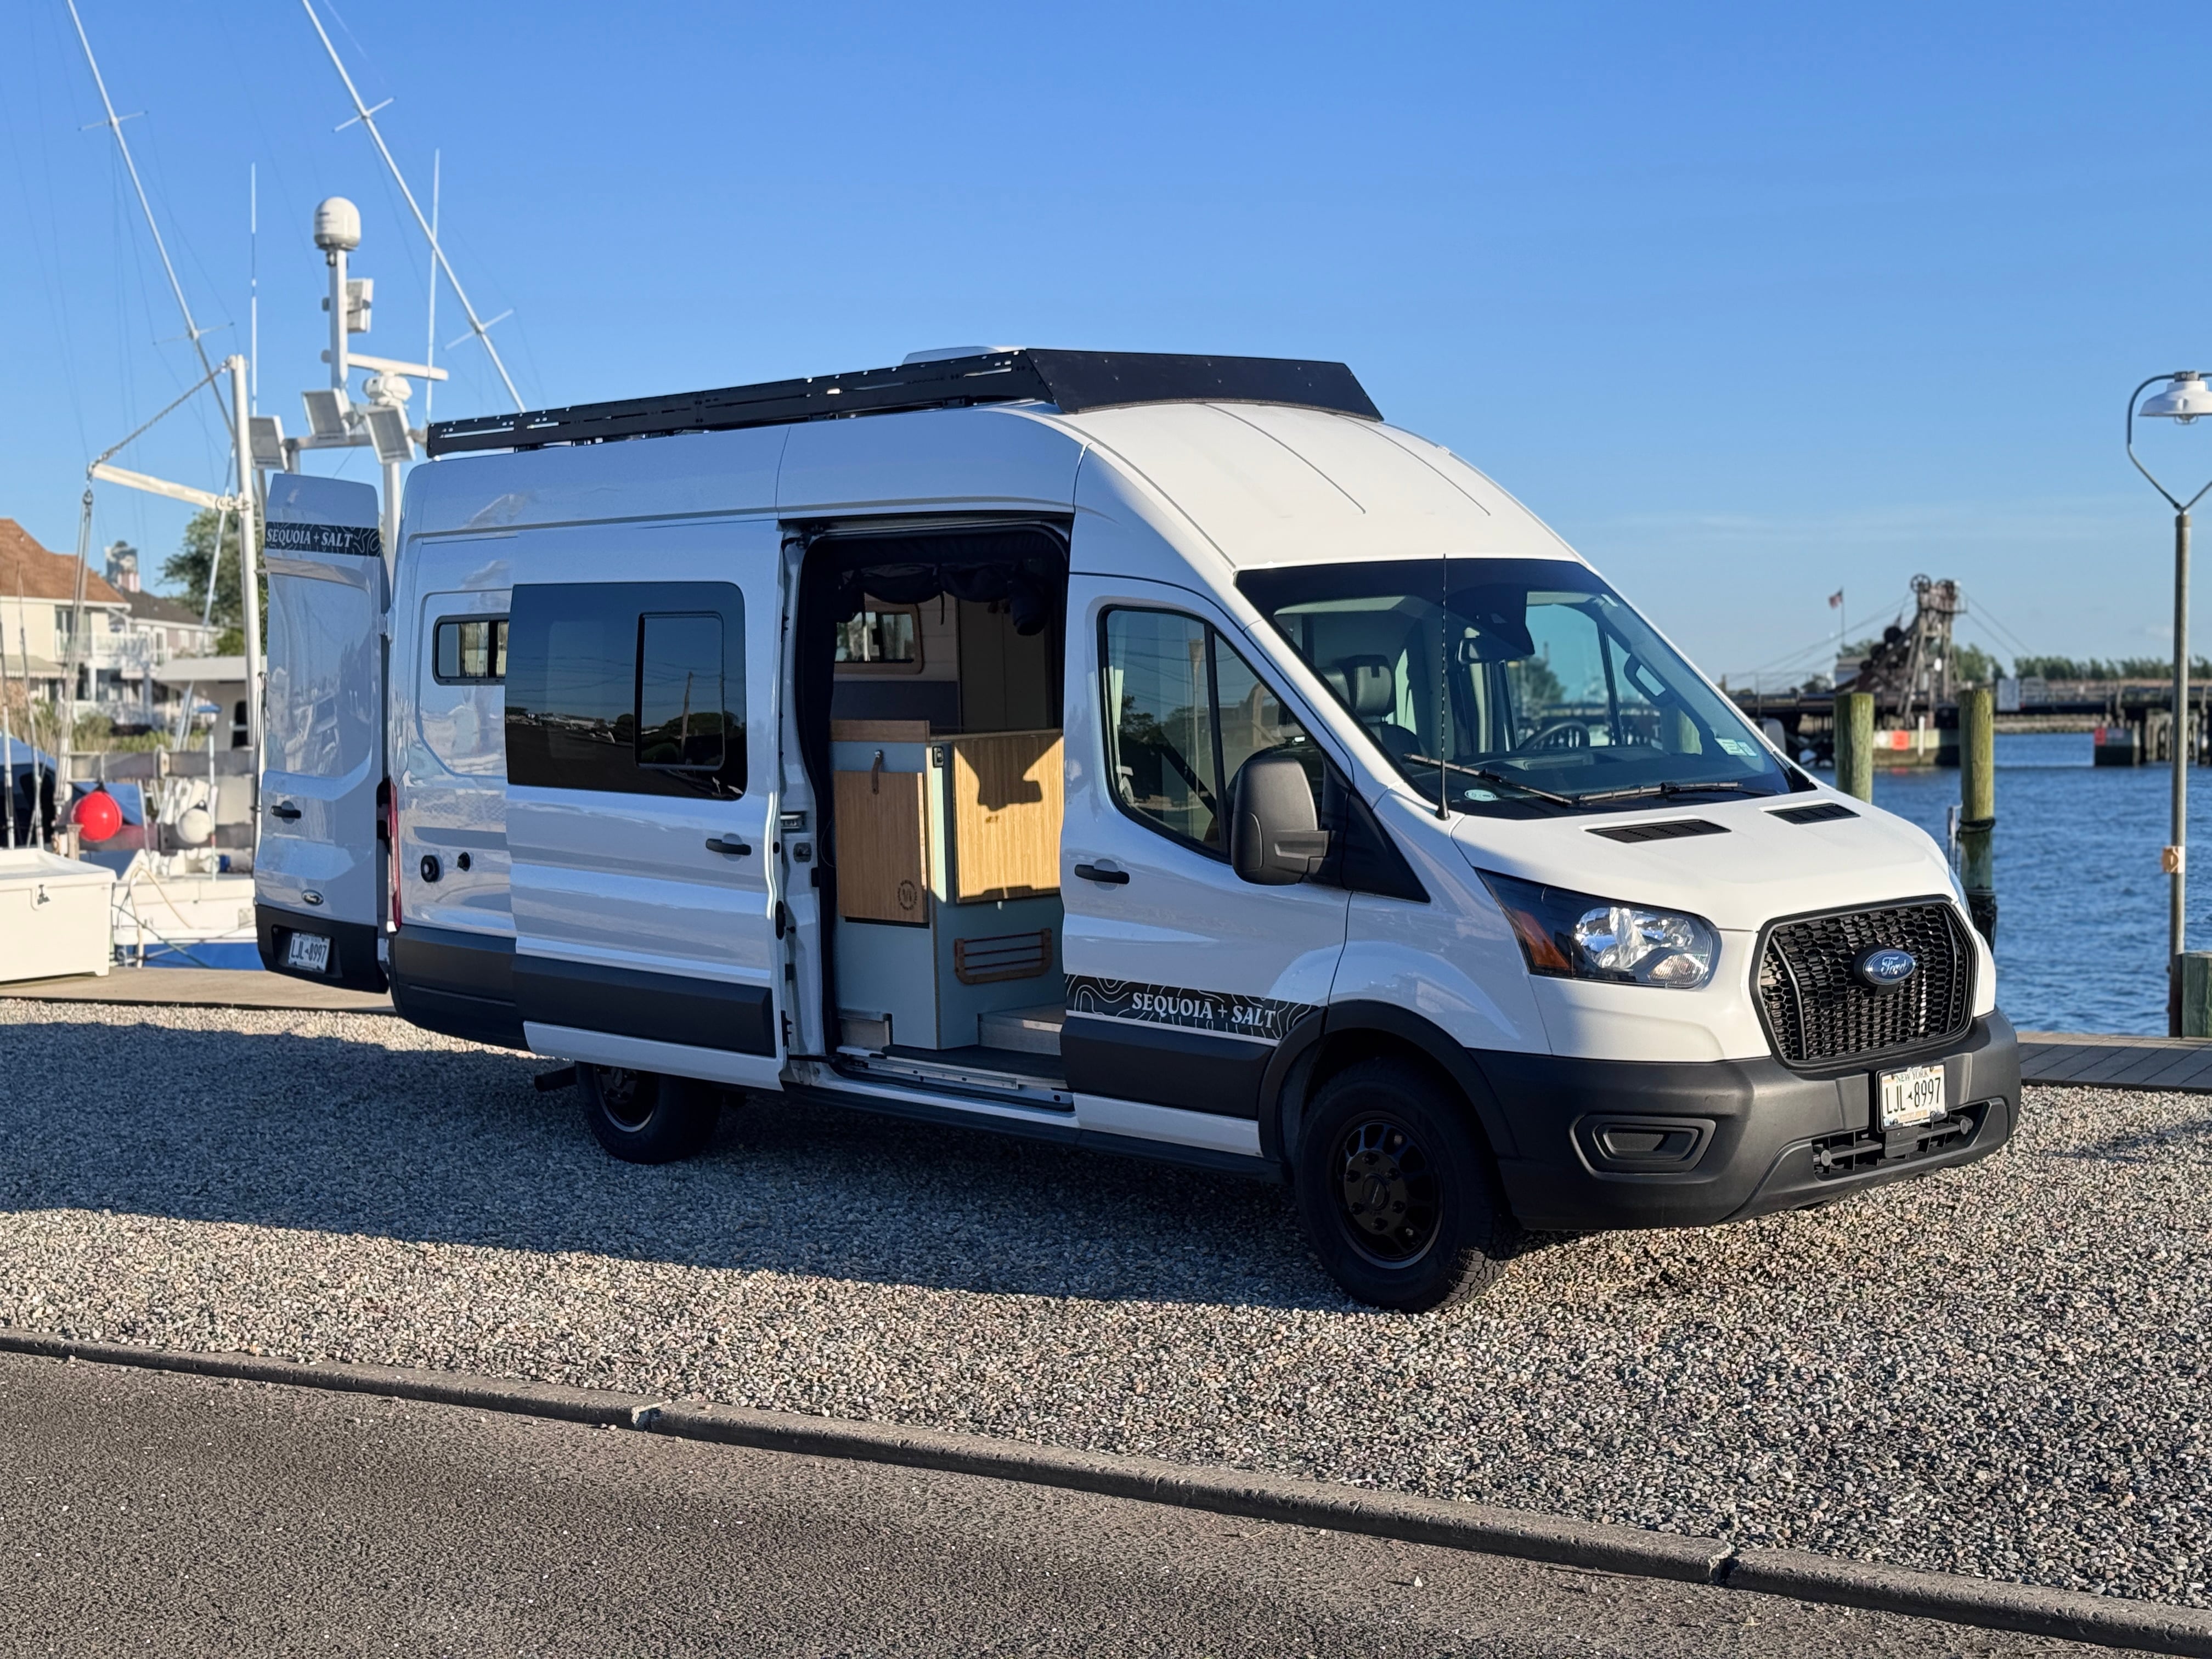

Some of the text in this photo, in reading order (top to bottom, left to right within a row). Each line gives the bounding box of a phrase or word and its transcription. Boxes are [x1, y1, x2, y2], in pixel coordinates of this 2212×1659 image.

[266, 528, 311, 546] SEQUOIA
[321, 532, 353, 548] SALT
[308, 943, 327, 964] 8997
[1881, 956, 1908, 976] Ford
[1132, 992, 1214, 1020] SEQUOIA
[1231, 1006, 1277, 1029] SALT
[1895, 1069, 1929, 1084] NEW YORK
[1886, 1077, 1941, 1114] LJL 8997
